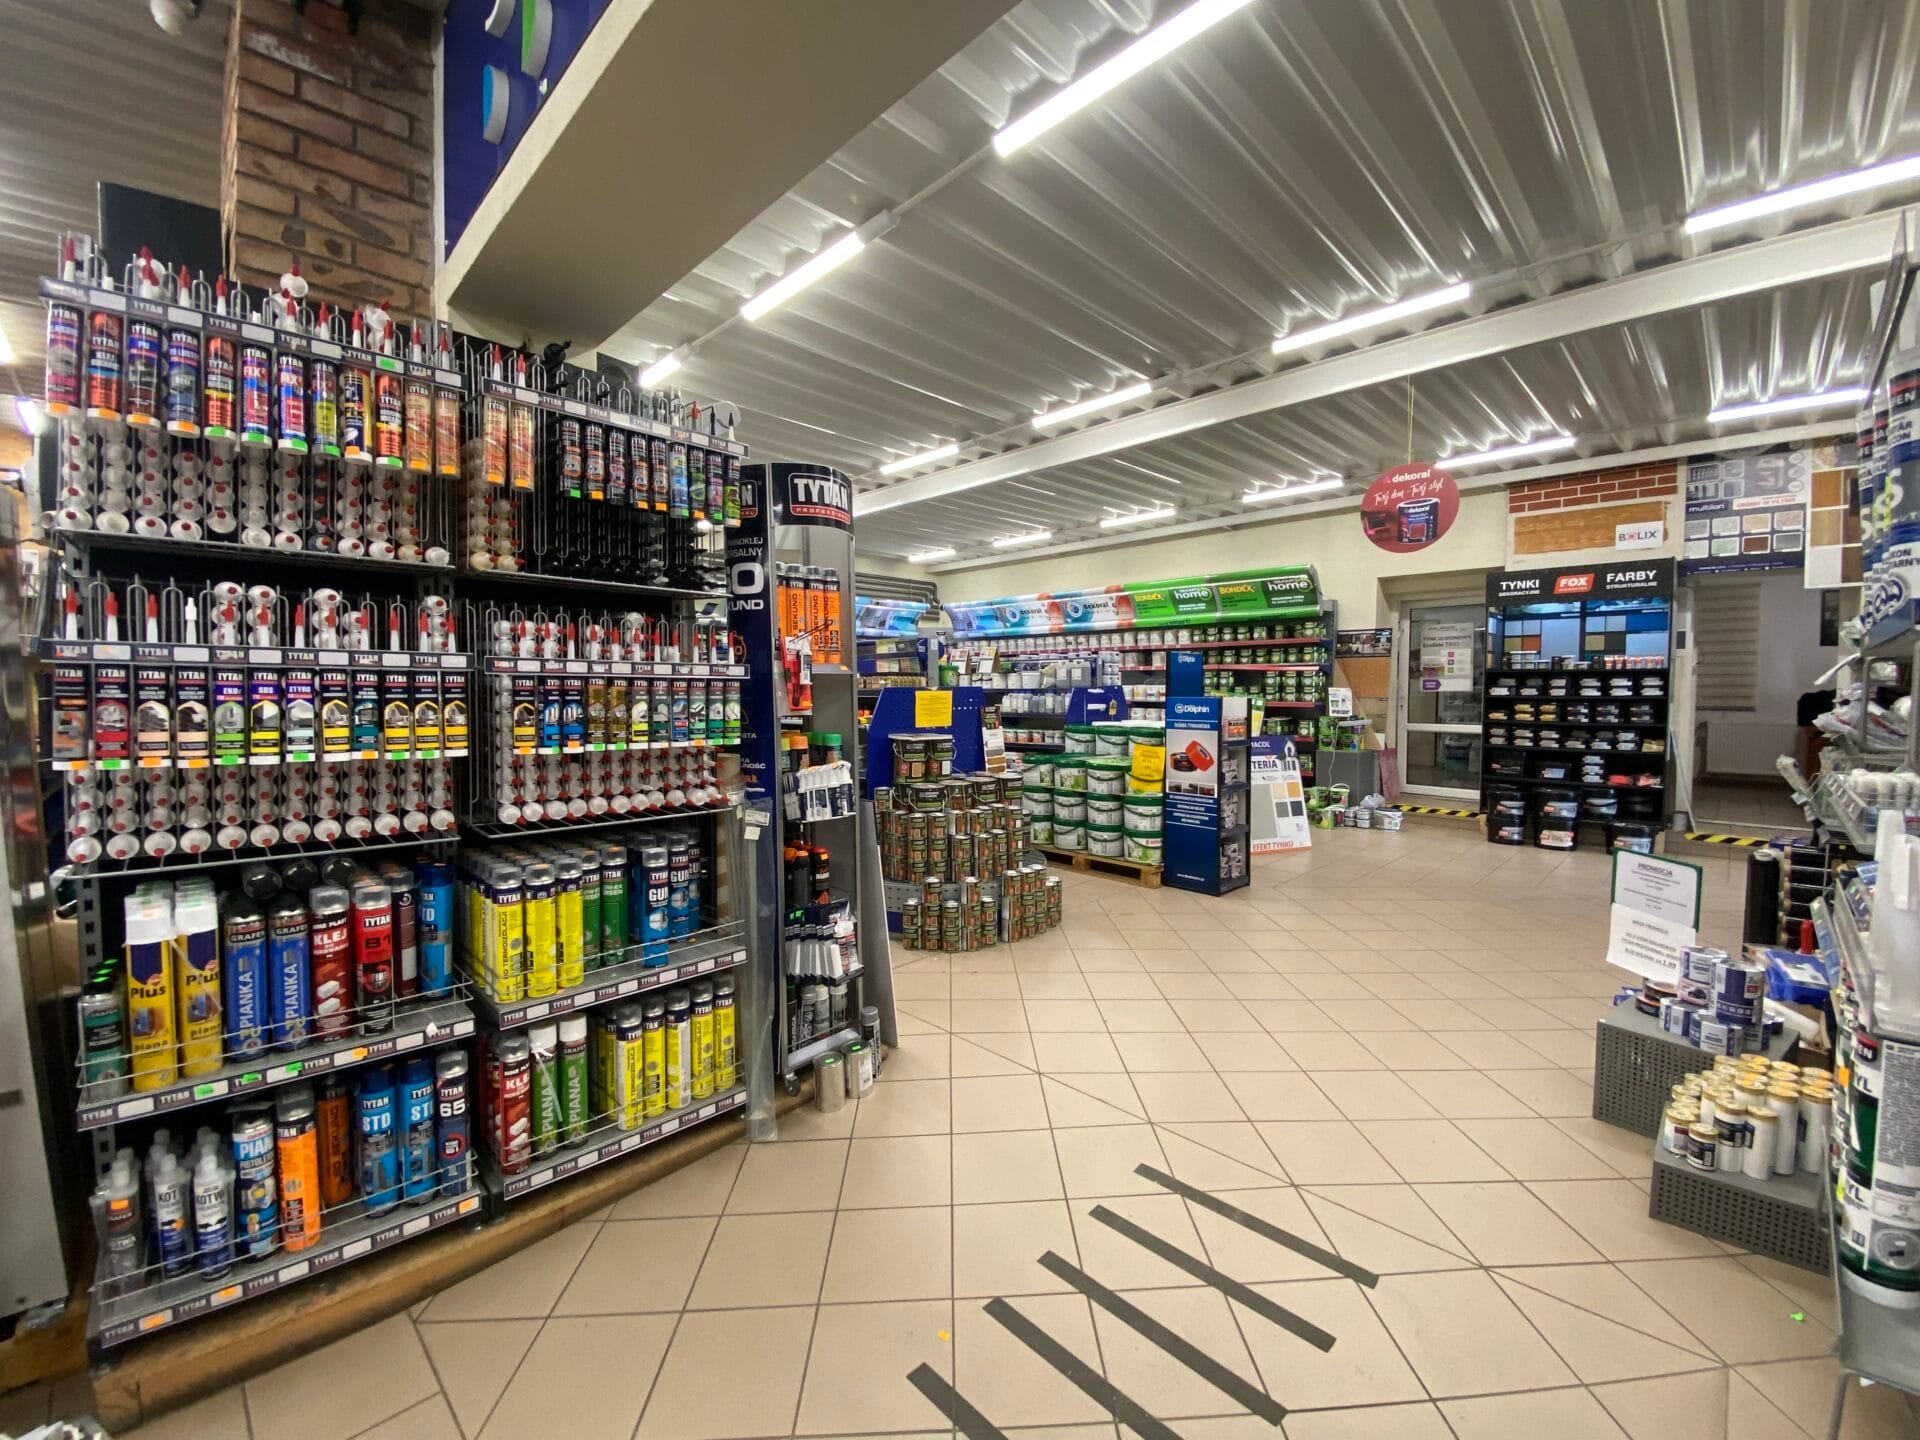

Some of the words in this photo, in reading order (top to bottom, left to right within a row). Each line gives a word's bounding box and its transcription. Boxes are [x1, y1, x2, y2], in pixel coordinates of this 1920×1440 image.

[134, 301, 163, 314] TYTAN
[209, 318, 237, 331] TYTAN
[1392, 469, 1431, 483] dekoral
[794, 478, 848, 511] TYTAN
[1607, 570, 1657, 583] FARBY
[1267, 579, 1308, 592] home
[1500, 579, 1540, 591] TYNKI
[1560, 577, 1588, 588] FOX
[1174, 588, 1210, 600] home
[139, 647, 169, 656] TYTAN
[287, 652, 315, 661] TYTAN
[415, 655, 438, 663] TYTAN
[56, 668, 83, 678] TYTAN
[98, 669, 126, 679] TYTAN
[139, 671, 166, 680] TYTAN
[178, 671, 206, 681] TYTAN
[217, 672, 243, 681] TYTAN
[252, 672, 278, 681] TYTAN
[288, 671, 312, 680] TYTAN
[323, 672, 347, 681] TYTAN
[356, 673, 378, 683] TYTAN
[385, 675, 407, 683] TYTAN
[415, 675, 437, 684] TYTAN
[445, 675, 465, 684] TYTAN
[1638, 862, 1673, 877] PROMOCJA
[313, 928, 347, 945] KLEJ
[553, 998, 571, 1010] TYTAN
[504, 1011, 524, 1023] TYTAN
[441, 1085, 464, 1097] TYTAN
[363, 1096, 390, 1109] TYTAN
[440, 1099, 466, 1117] 65
[362, 1112, 391, 1132] STD
